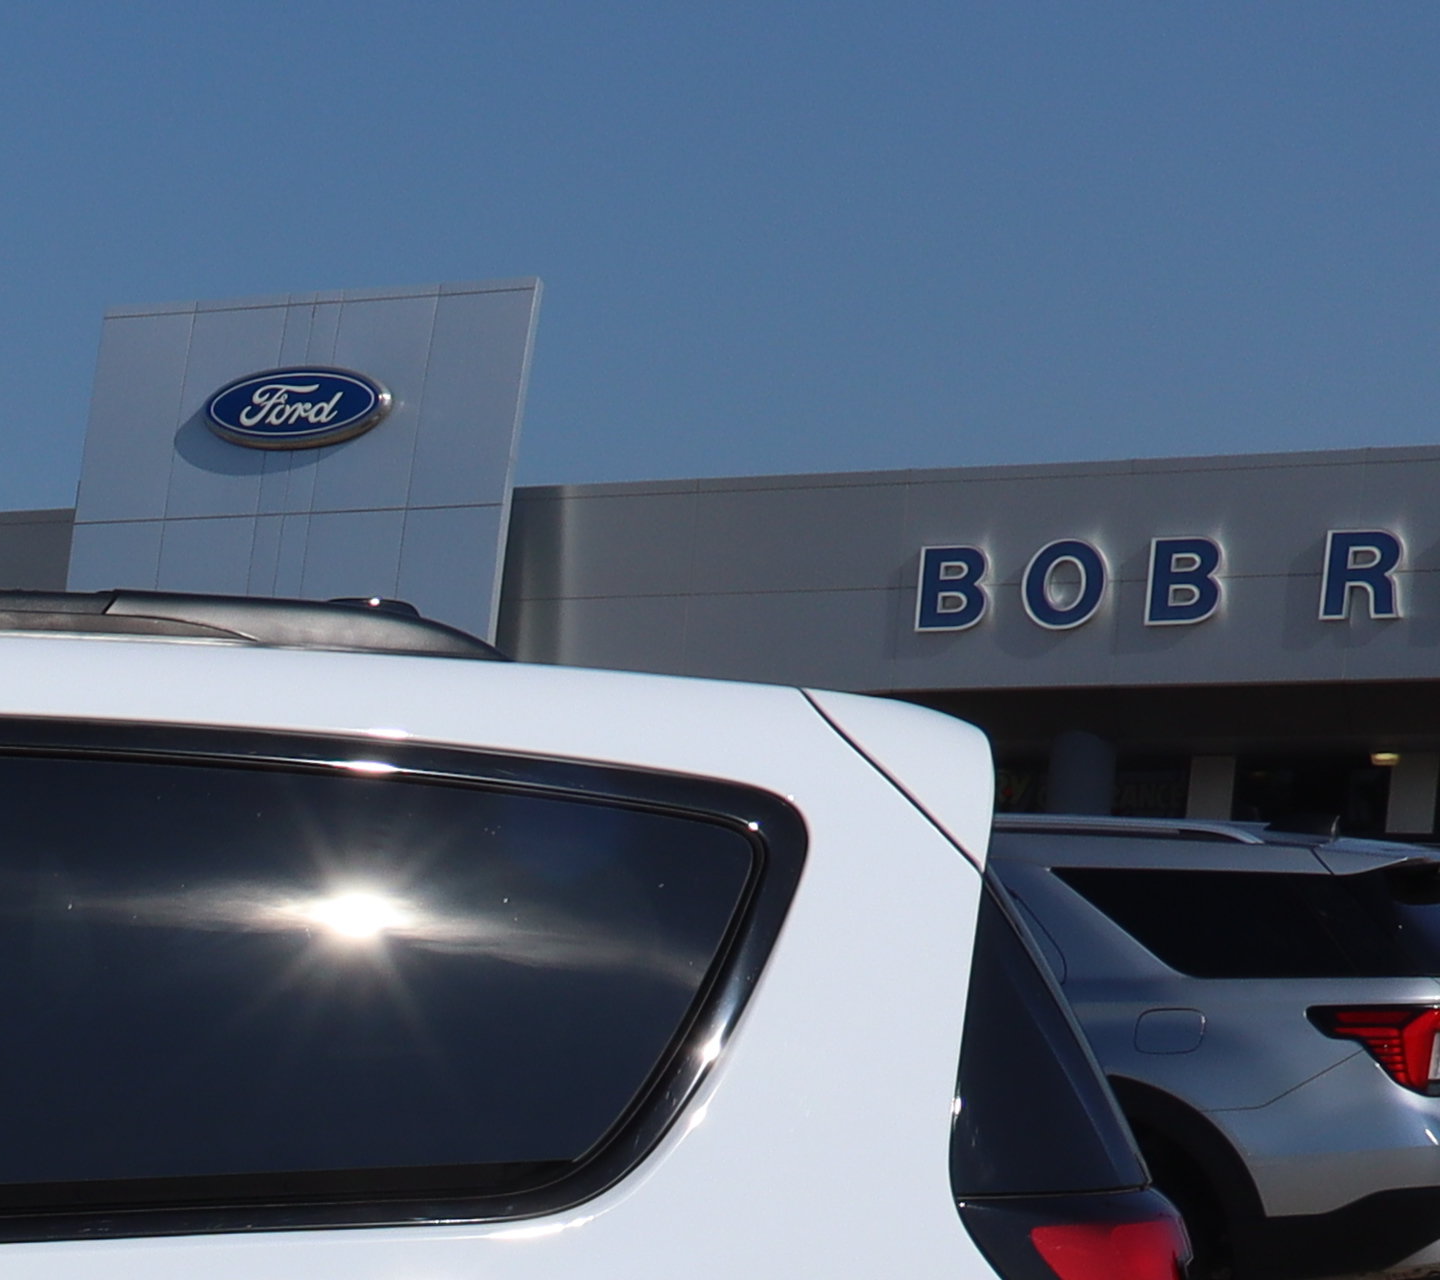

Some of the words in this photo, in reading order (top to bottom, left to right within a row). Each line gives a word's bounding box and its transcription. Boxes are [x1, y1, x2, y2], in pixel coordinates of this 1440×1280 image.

[239, 383, 344, 427] Ford
[914, 536, 1226, 632] BOB
[1318, 529, 1404, 621] R
